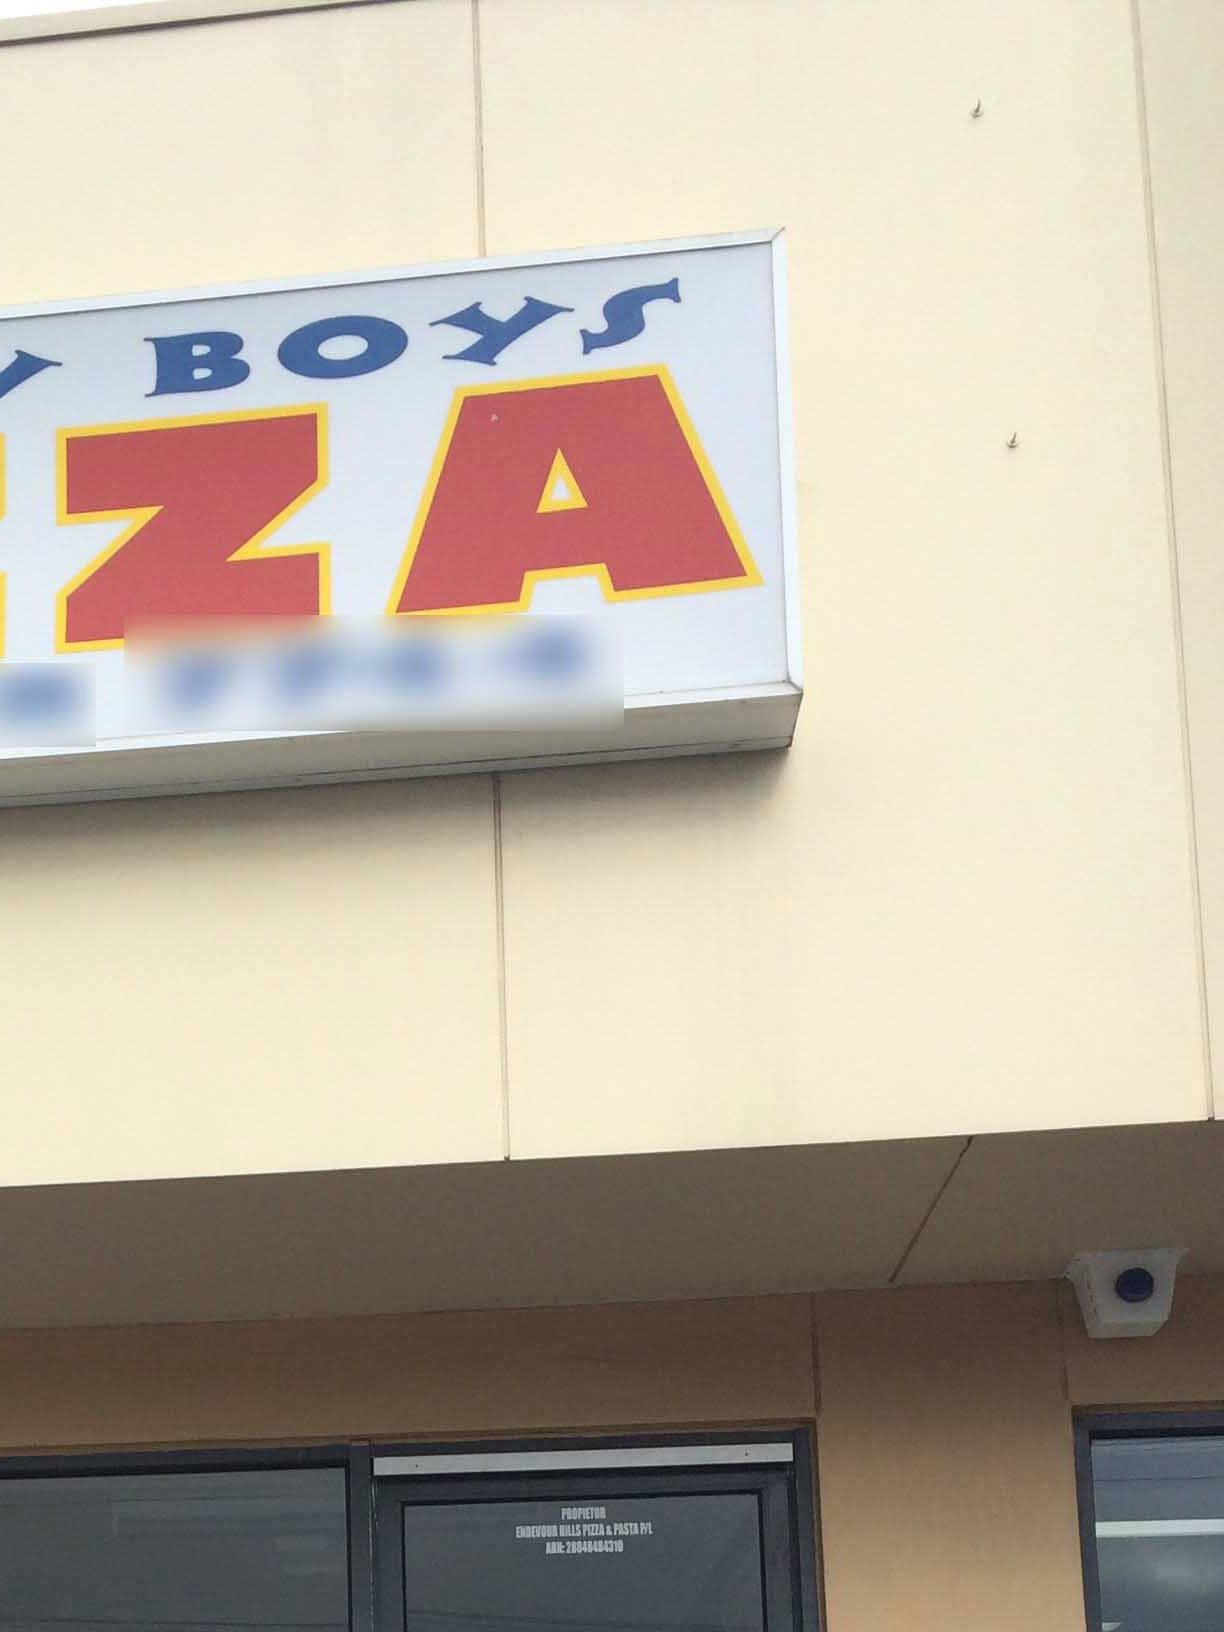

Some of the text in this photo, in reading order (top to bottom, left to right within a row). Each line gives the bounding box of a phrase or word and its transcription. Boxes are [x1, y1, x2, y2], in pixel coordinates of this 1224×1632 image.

[144, 277, 682, 398] BOYS
[582, 1523, 604, 1536] PIZZA
[606, 1525, 613, 1535] &
[614, 1523, 639, 1535] PASTA
